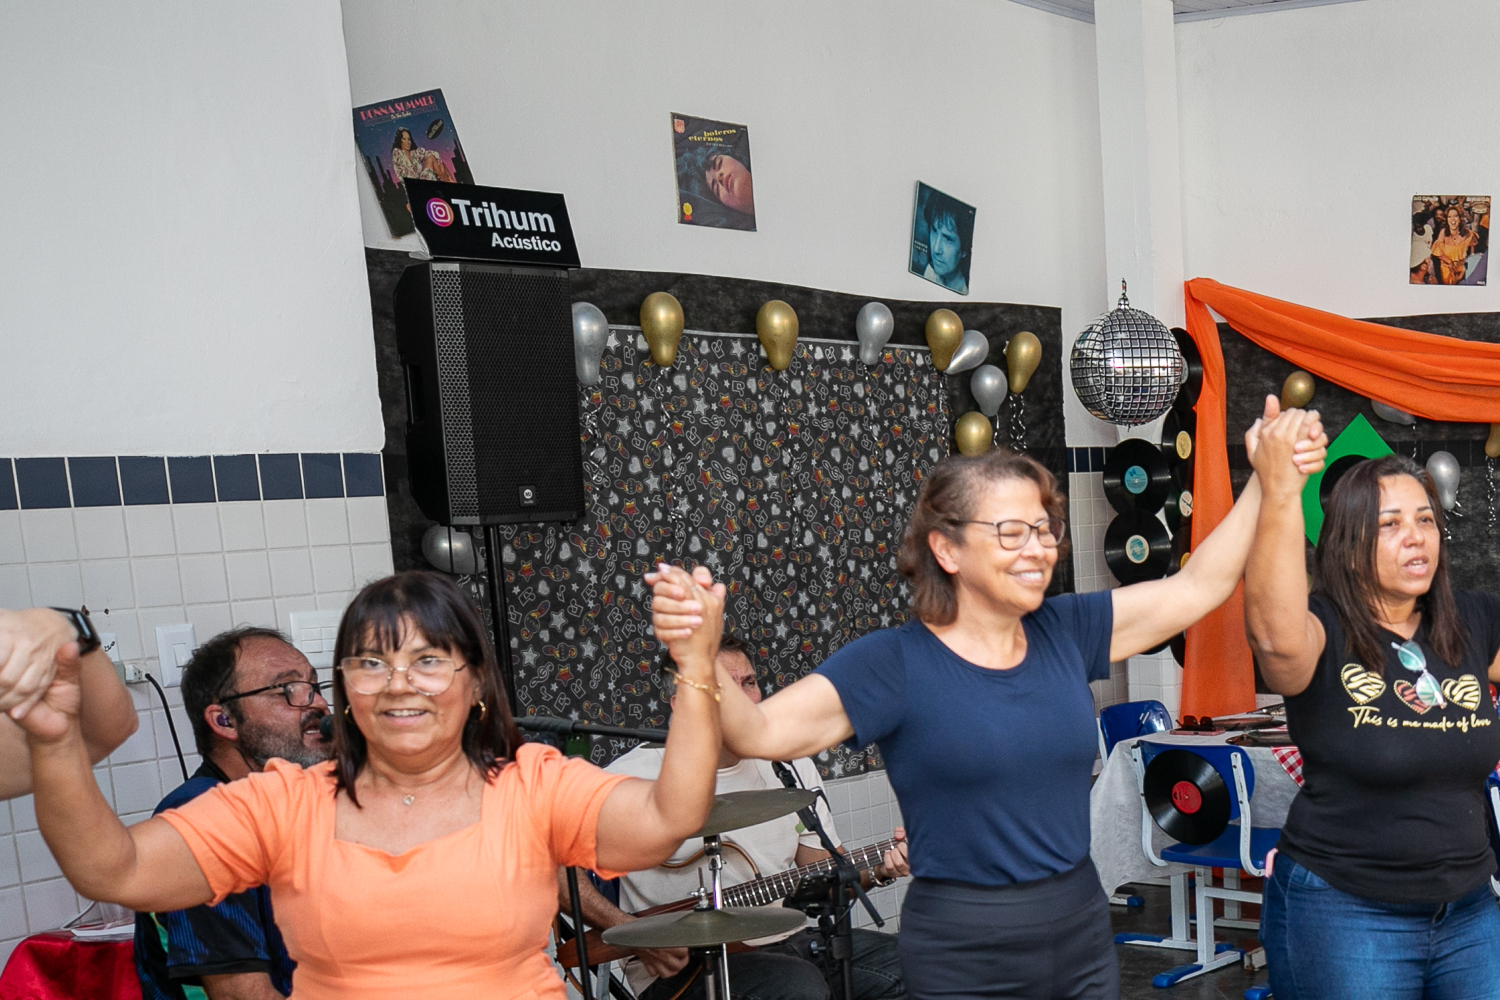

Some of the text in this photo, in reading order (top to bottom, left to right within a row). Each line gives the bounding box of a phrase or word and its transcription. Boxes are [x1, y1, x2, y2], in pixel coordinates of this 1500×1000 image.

[394, 95, 436, 112] SUMMER
[703, 128, 737, 137] boleros
[451, 198, 556, 233] Trihum
[491, 232, 561, 252] Acústico
[1347, 705, 1491, 733] This is me made of love
